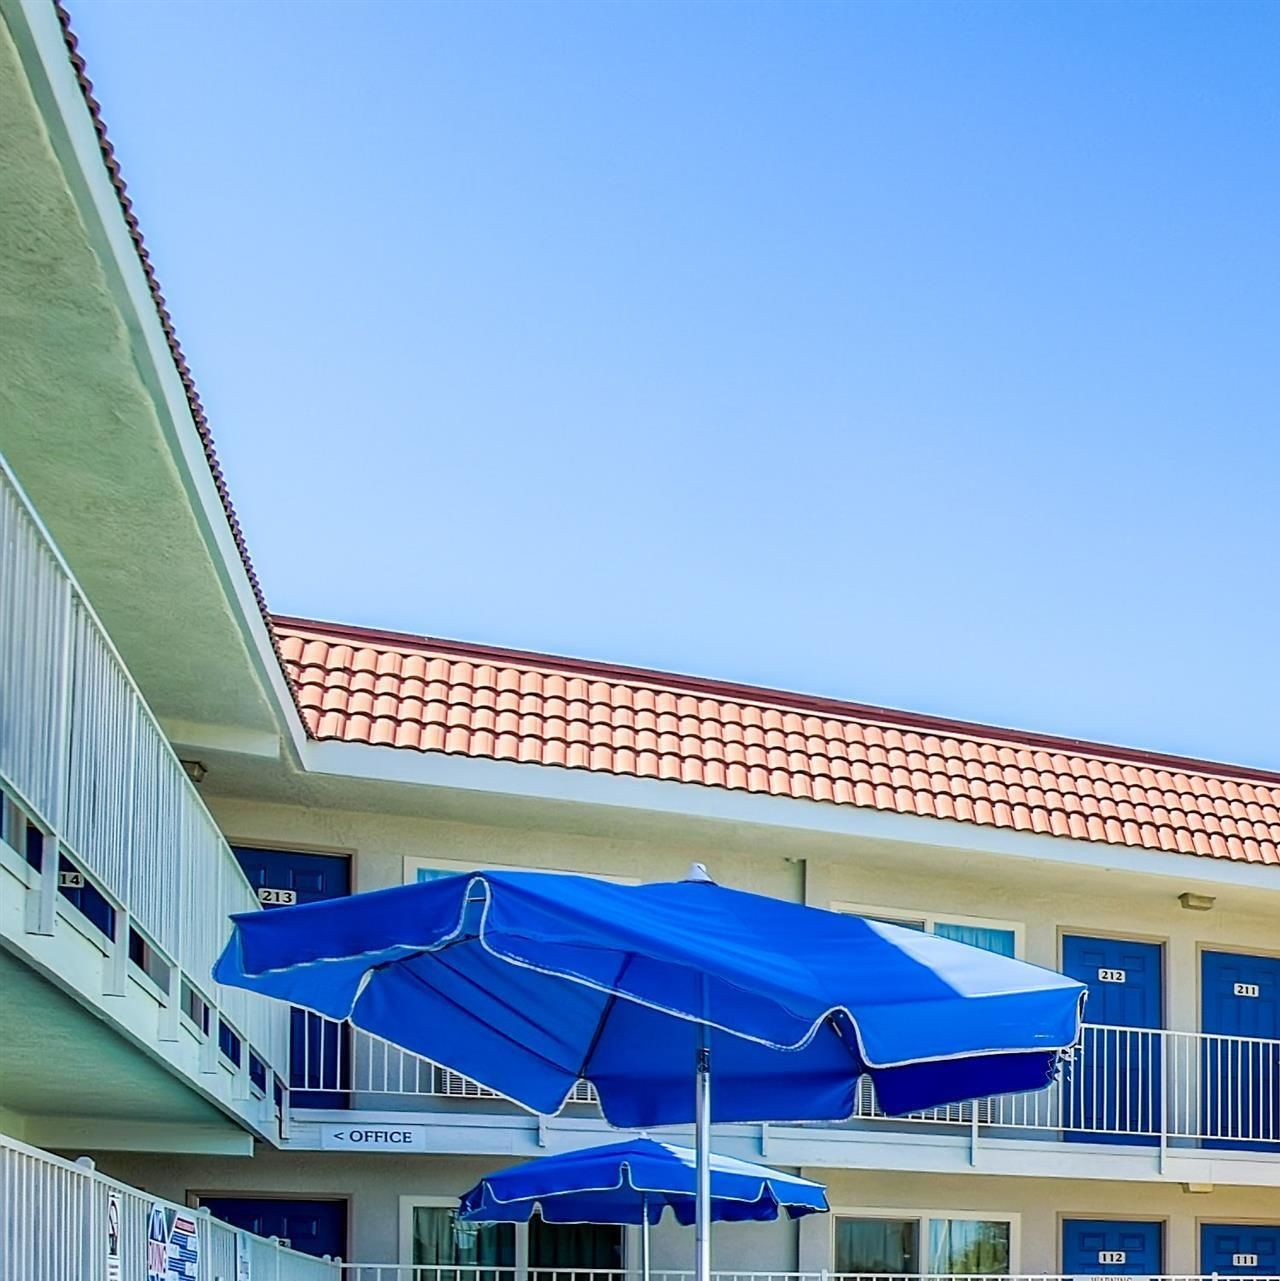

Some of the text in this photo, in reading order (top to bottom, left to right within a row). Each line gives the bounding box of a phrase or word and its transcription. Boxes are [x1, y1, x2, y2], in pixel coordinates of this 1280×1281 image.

[60, 874, 81, 886] 14
[262, 890, 293, 903] 213
[1101, 970, 1123, 981] 212
[1237, 984, 1256, 995] 211
[350, 1130, 413, 1144] OFFICE
[1101, 1253, 1123, 1263] 112
[1236, 1256, 1255, 1265] 111
